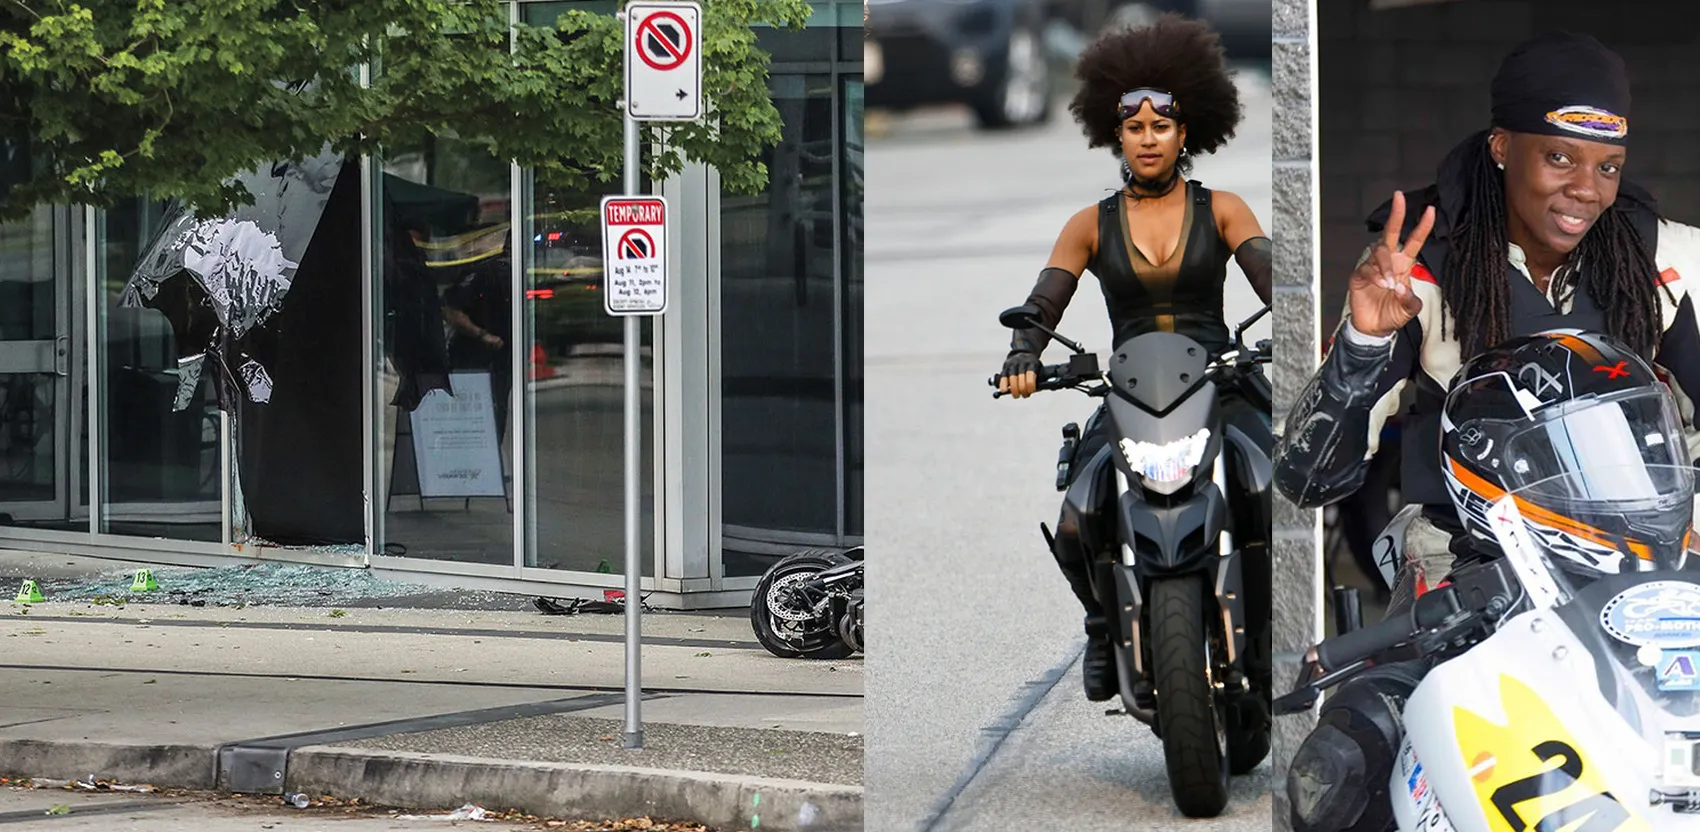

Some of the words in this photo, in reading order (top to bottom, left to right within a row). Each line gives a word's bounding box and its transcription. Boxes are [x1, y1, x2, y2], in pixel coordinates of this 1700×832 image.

[608, 206, 662, 222] TEMPORARY
[136, 571, 146, 584] 13
[21, 583, 31, 595] 12
